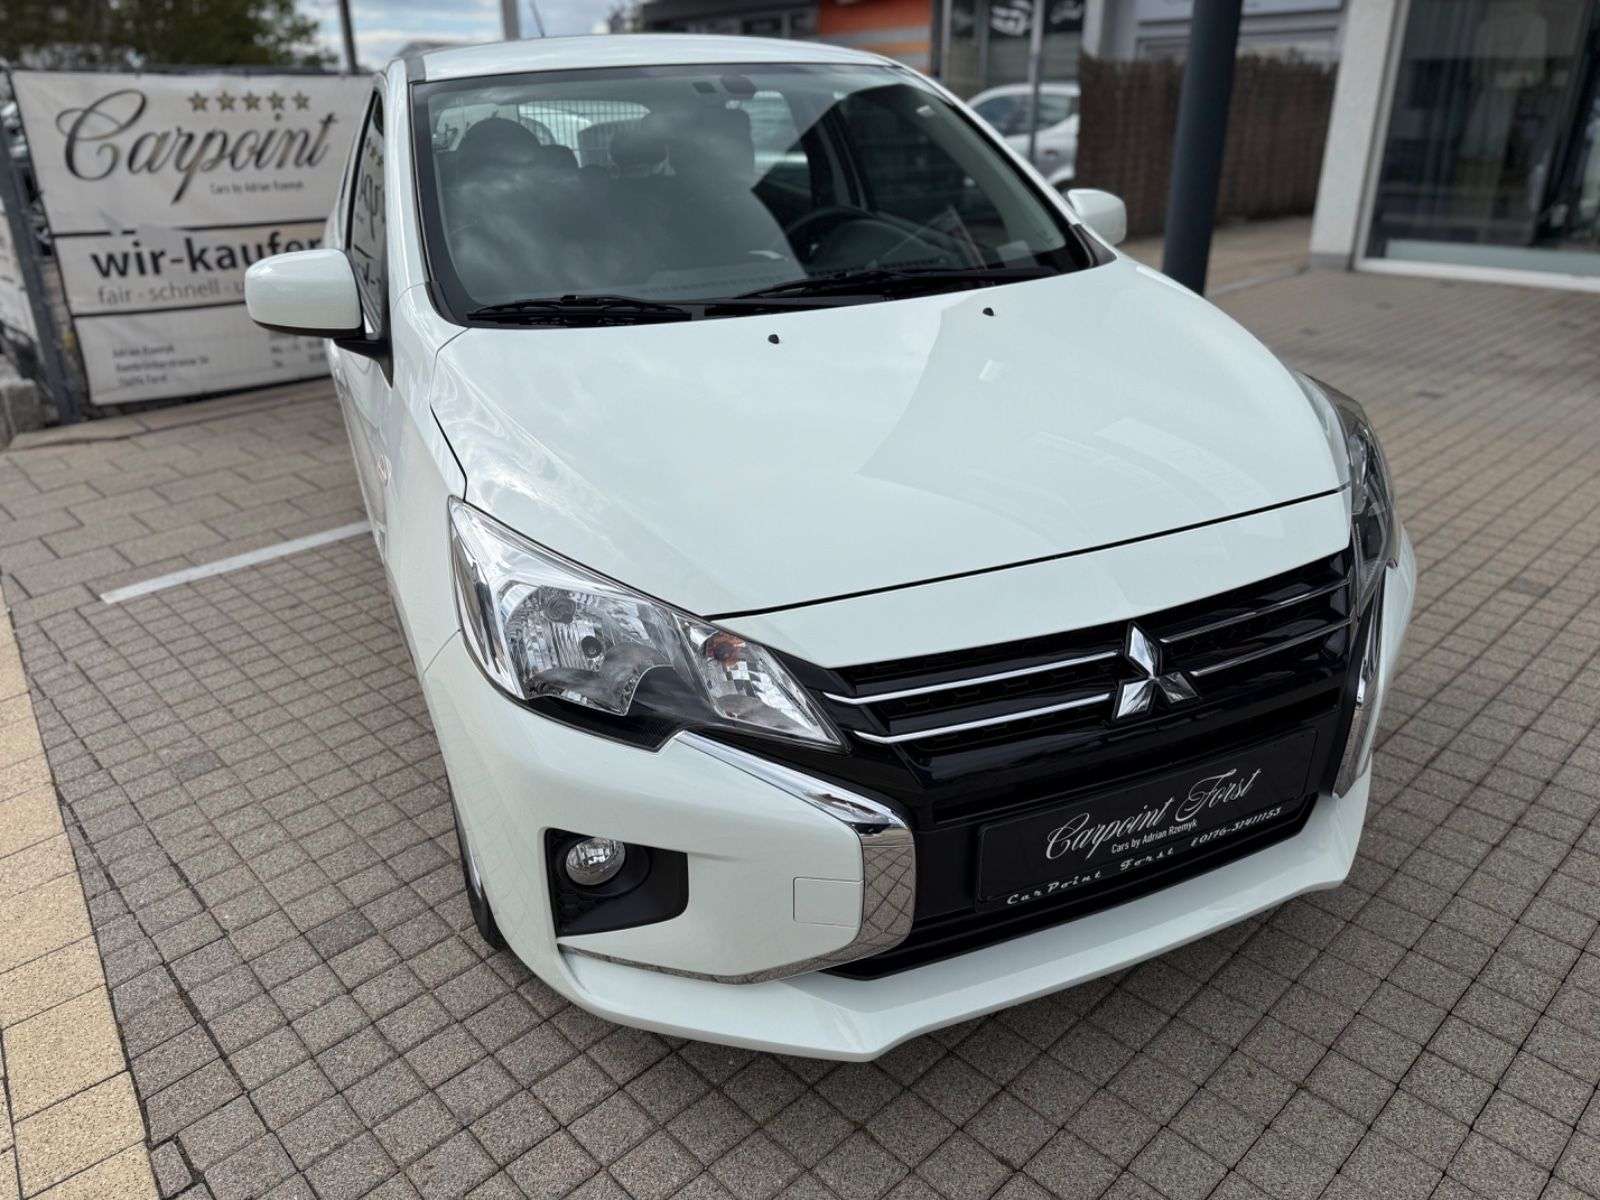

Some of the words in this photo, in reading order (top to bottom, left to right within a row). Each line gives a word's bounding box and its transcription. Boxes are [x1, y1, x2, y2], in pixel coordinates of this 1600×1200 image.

[56, 88, 338, 204] Carpoint
[99, 286, 131, 304] fair
[150, 280, 220, 300] schnell
[1046, 797, 1174, 861] Carpoint
[1175, 768, 1261, 822] Forst
[1111, 842, 1130, 854] Cars
[1131, 838, 1141, 849] by
[1142, 830, 1168, 844] Adrian
